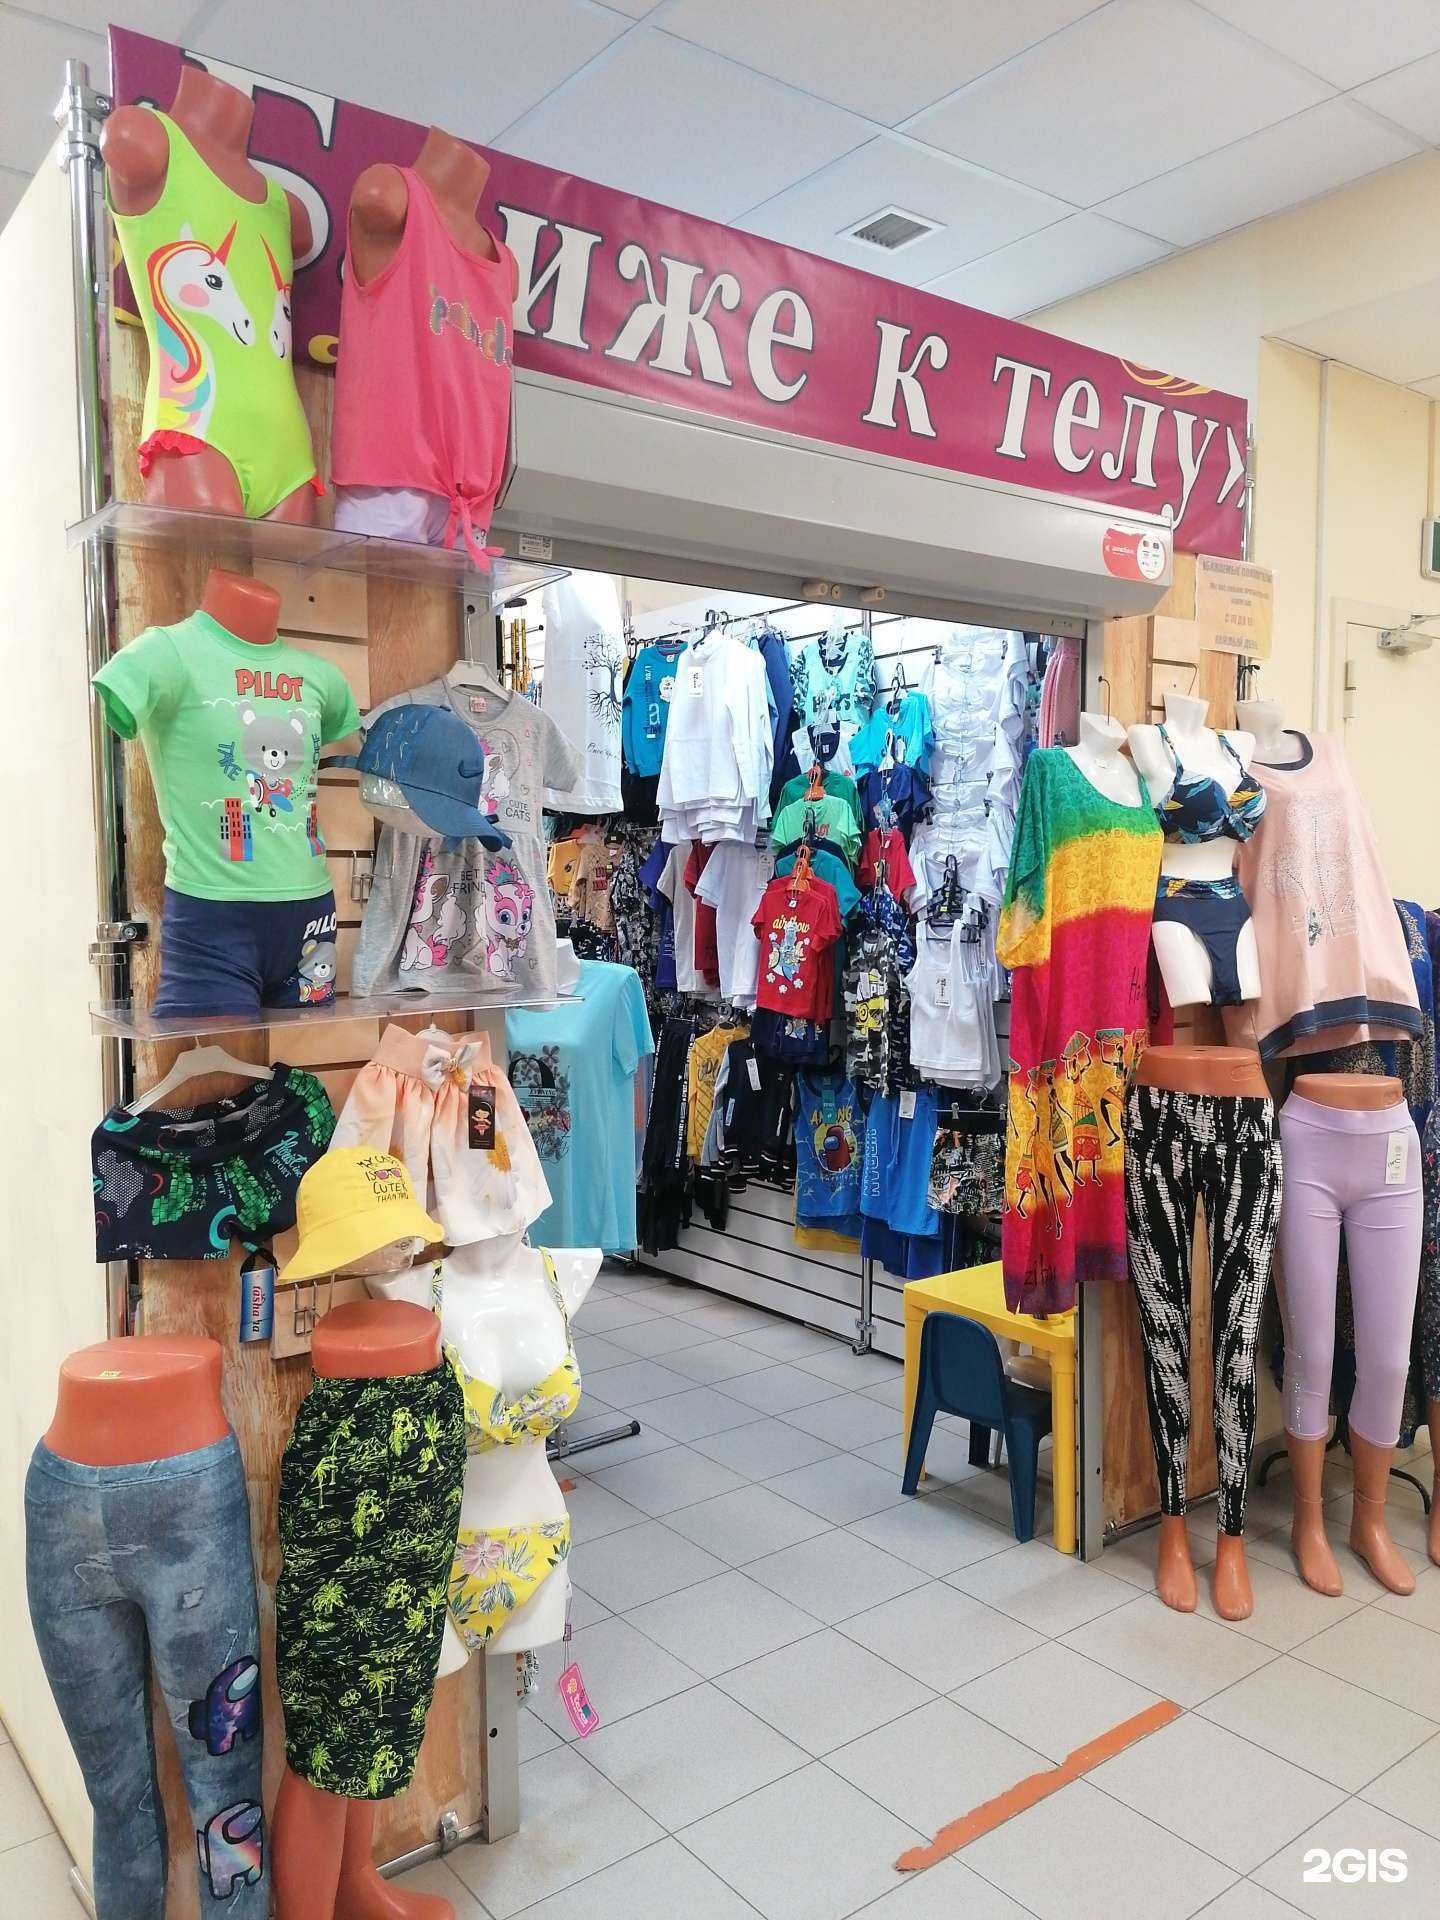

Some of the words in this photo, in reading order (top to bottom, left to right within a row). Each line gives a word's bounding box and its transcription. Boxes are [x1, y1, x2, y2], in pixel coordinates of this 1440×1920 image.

[861, 320, 950, 438] к
[235, 668, 304, 702] PILOT
[217, 741, 242, 781] TAKE
[505, 807, 531, 823] CATS
[508, 799, 529, 812] CUTE
[272, 1156, 292, 1178] SPORT
